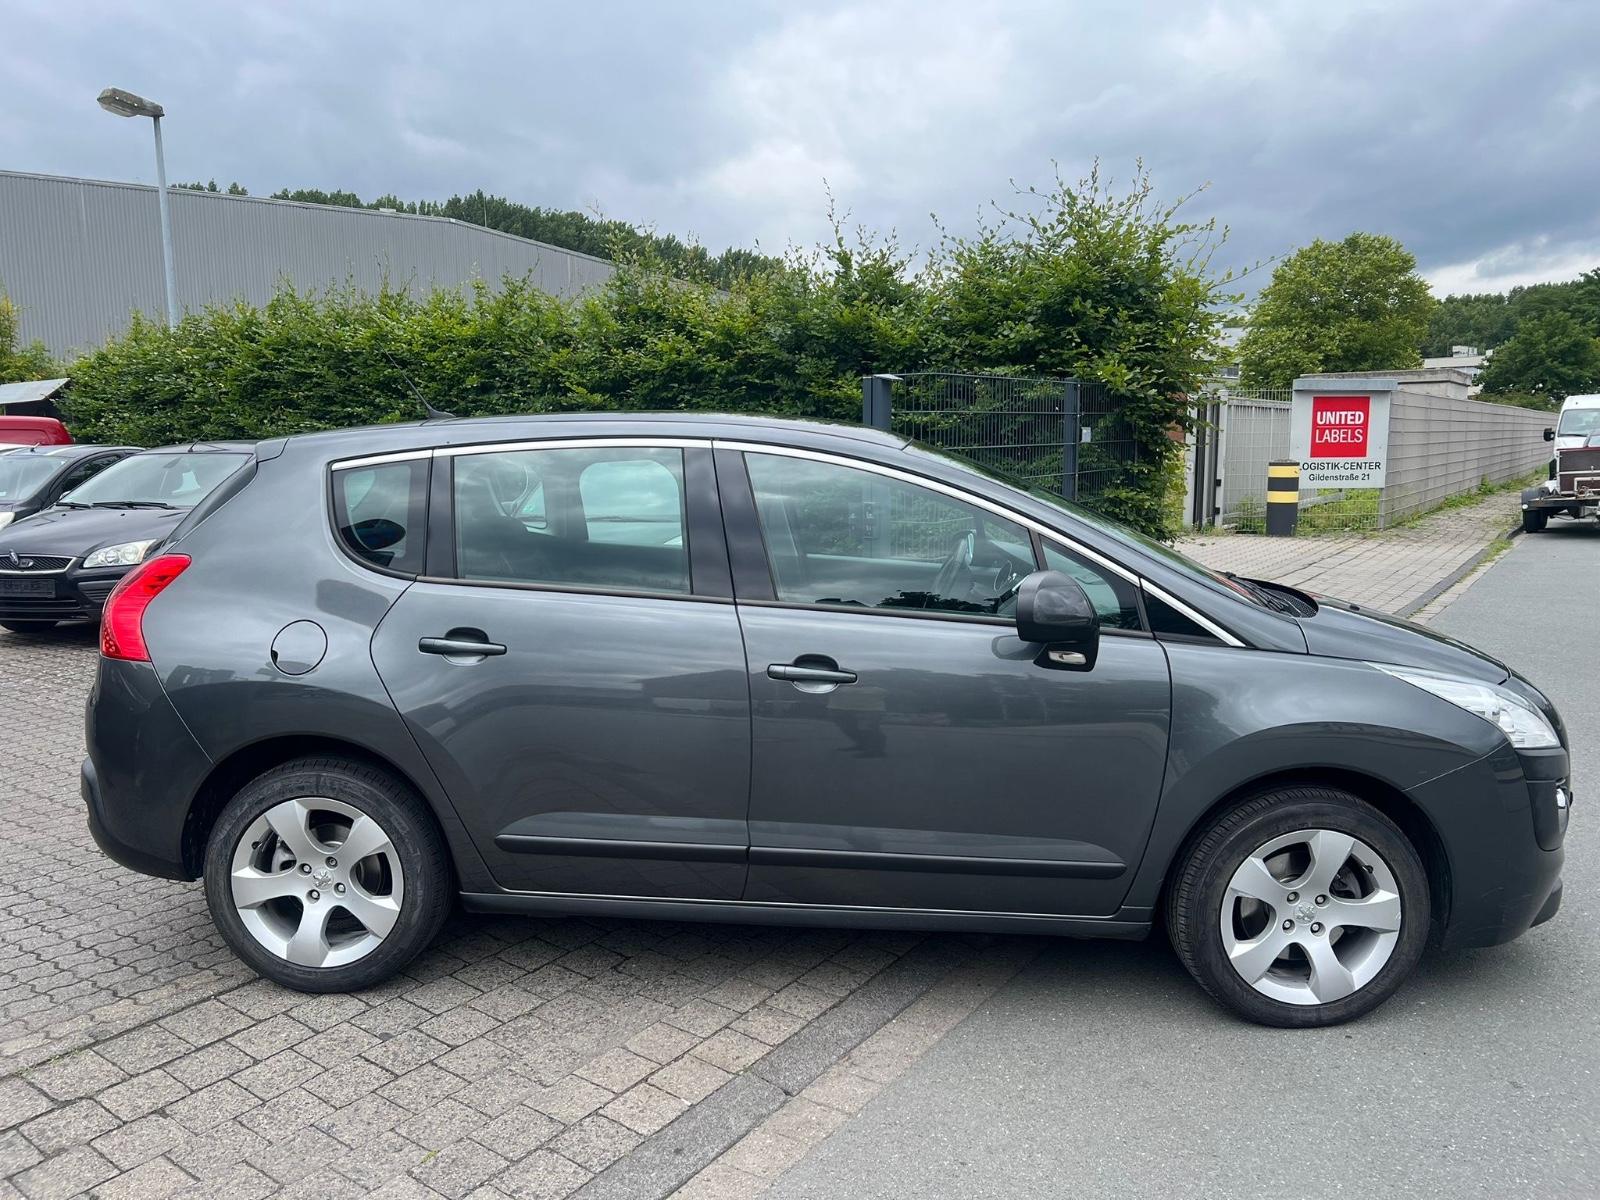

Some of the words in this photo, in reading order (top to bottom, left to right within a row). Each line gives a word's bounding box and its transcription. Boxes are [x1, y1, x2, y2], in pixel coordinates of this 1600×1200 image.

[1316, 411, 1365, 425] UNITED
[1315, 428, 1363, 443] LABELS
[1299, 461, 1381, 471] OGISTIK-CENTER
[1308, 473, 1359, 481] Gildenstraße
[1361, 472, 1370, 481] 21
